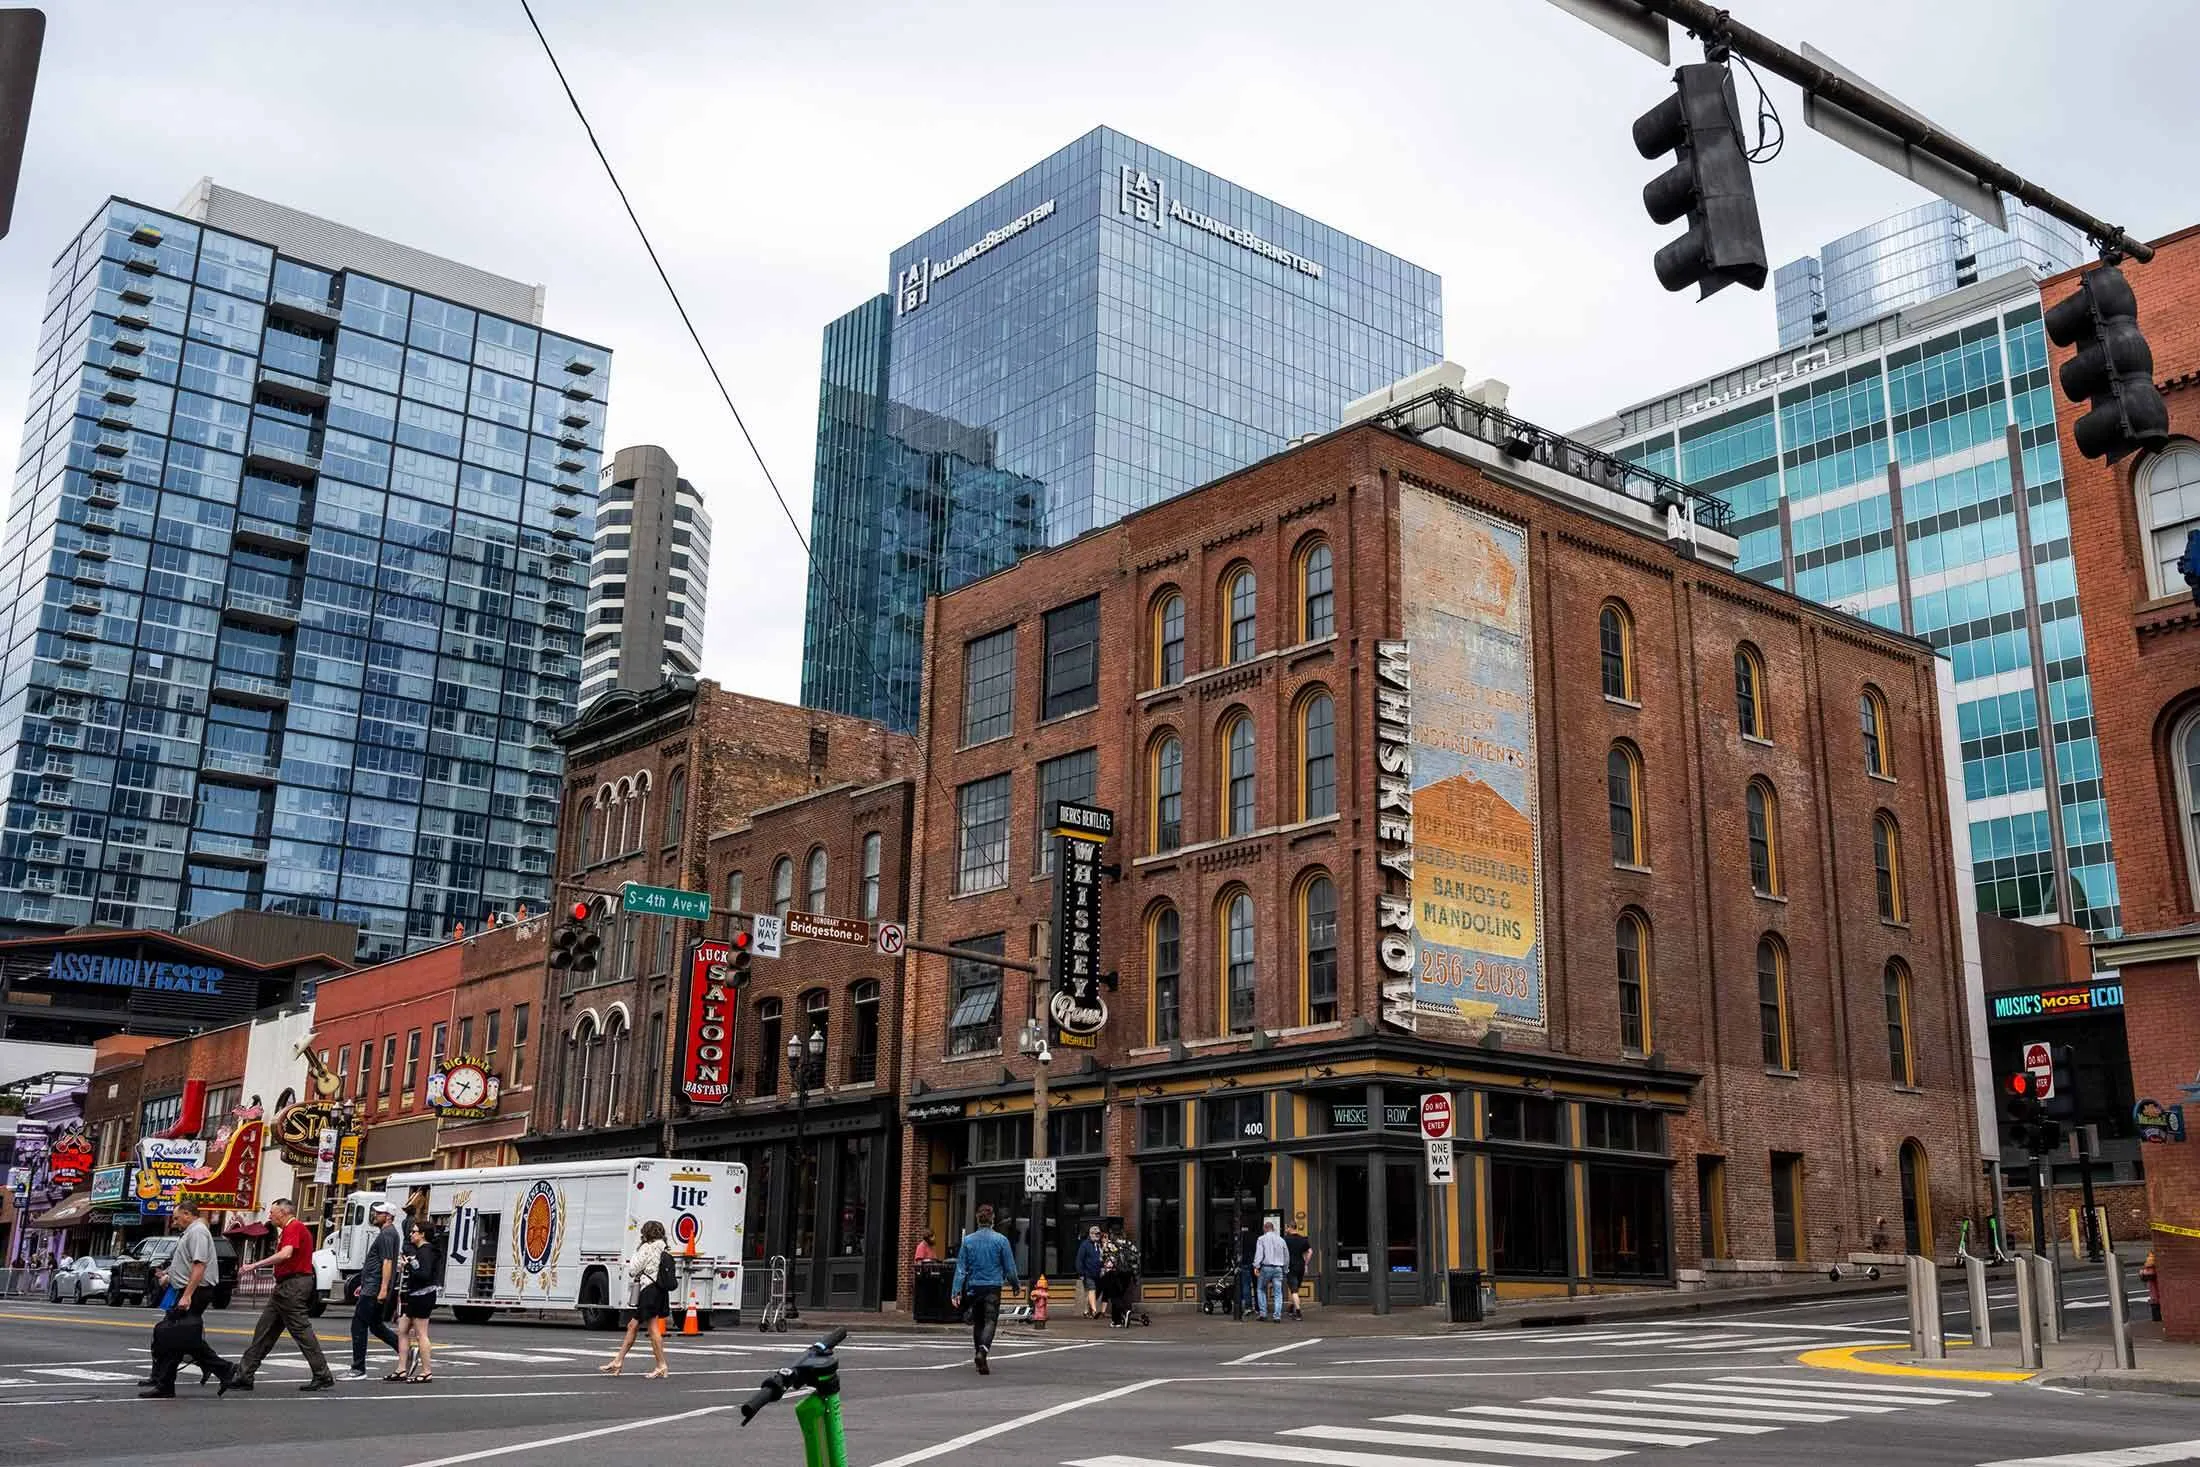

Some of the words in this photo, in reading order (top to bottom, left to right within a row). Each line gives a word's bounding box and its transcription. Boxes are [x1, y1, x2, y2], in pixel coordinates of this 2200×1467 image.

[1377, 640, 1414, 880] WHISKEY
[1060, 805, 1081, 825] DIERKS
[1462, 854, 1529, 886] GUITARS
[1433, 876, 1496, 907] BANJOS
[1500, 891, 1512, 910] &
[758, 917, 778, 930] ONE
[1072, 840, 1096, 998] WHISKEY
[1424, 901, 1521, 940] MANDOLINS
[757, 928, 778, 942] WAY
[791, 920, 852, 940] Bridgestone
[854, 932, 865, 942] Dr
[697, 949, 729, 963] LUCK
[1379, 893, 1417, 1033] ROW
[48, 951, 157, 988] ASSEMBLY
[156, 961, 225, 981] FOOD
[1421, 950, 1529, 1000] 256-2033
[155, 975, 223, 995] HALL
[1995, 994, 2042, 1018] MUSIC'S
[2041, 993, 2091, 1008] MOST
[2090, 985, 2124, 1008] ICO
[699, 964, 728, 1082] SALOON
[443, 1057, 463, 1071] BIG
[465, 1055, 491, 1073] TIME
[2028, 1056, 2036, 1065] DO
[2037, 1054, 2048, 1064] NOT
[684, 1081, 728, 1096] BASTARD
[1334, 1108, 1367, 1123] WHISKE
[1387, 1108, 1408, 1123] ROW
[1425, 1102, 1434, 1112] DO
[1435, 1101, 1447, 1111] NOT
[283, 1106, 362, 1142] STAE
[1244, 1122, 1263, 1136] 400
[1427, 1121, 1445, 1131] ENTER
[151, 1141, 201, 1160] Robert's
[1432, 1143, 1448, 1154] ONE
[1432, 1154, 1450, 1166] WAY
[1026, 1175, 1039, 1187] OK
[670, 1185, 708, 1212] Lite
